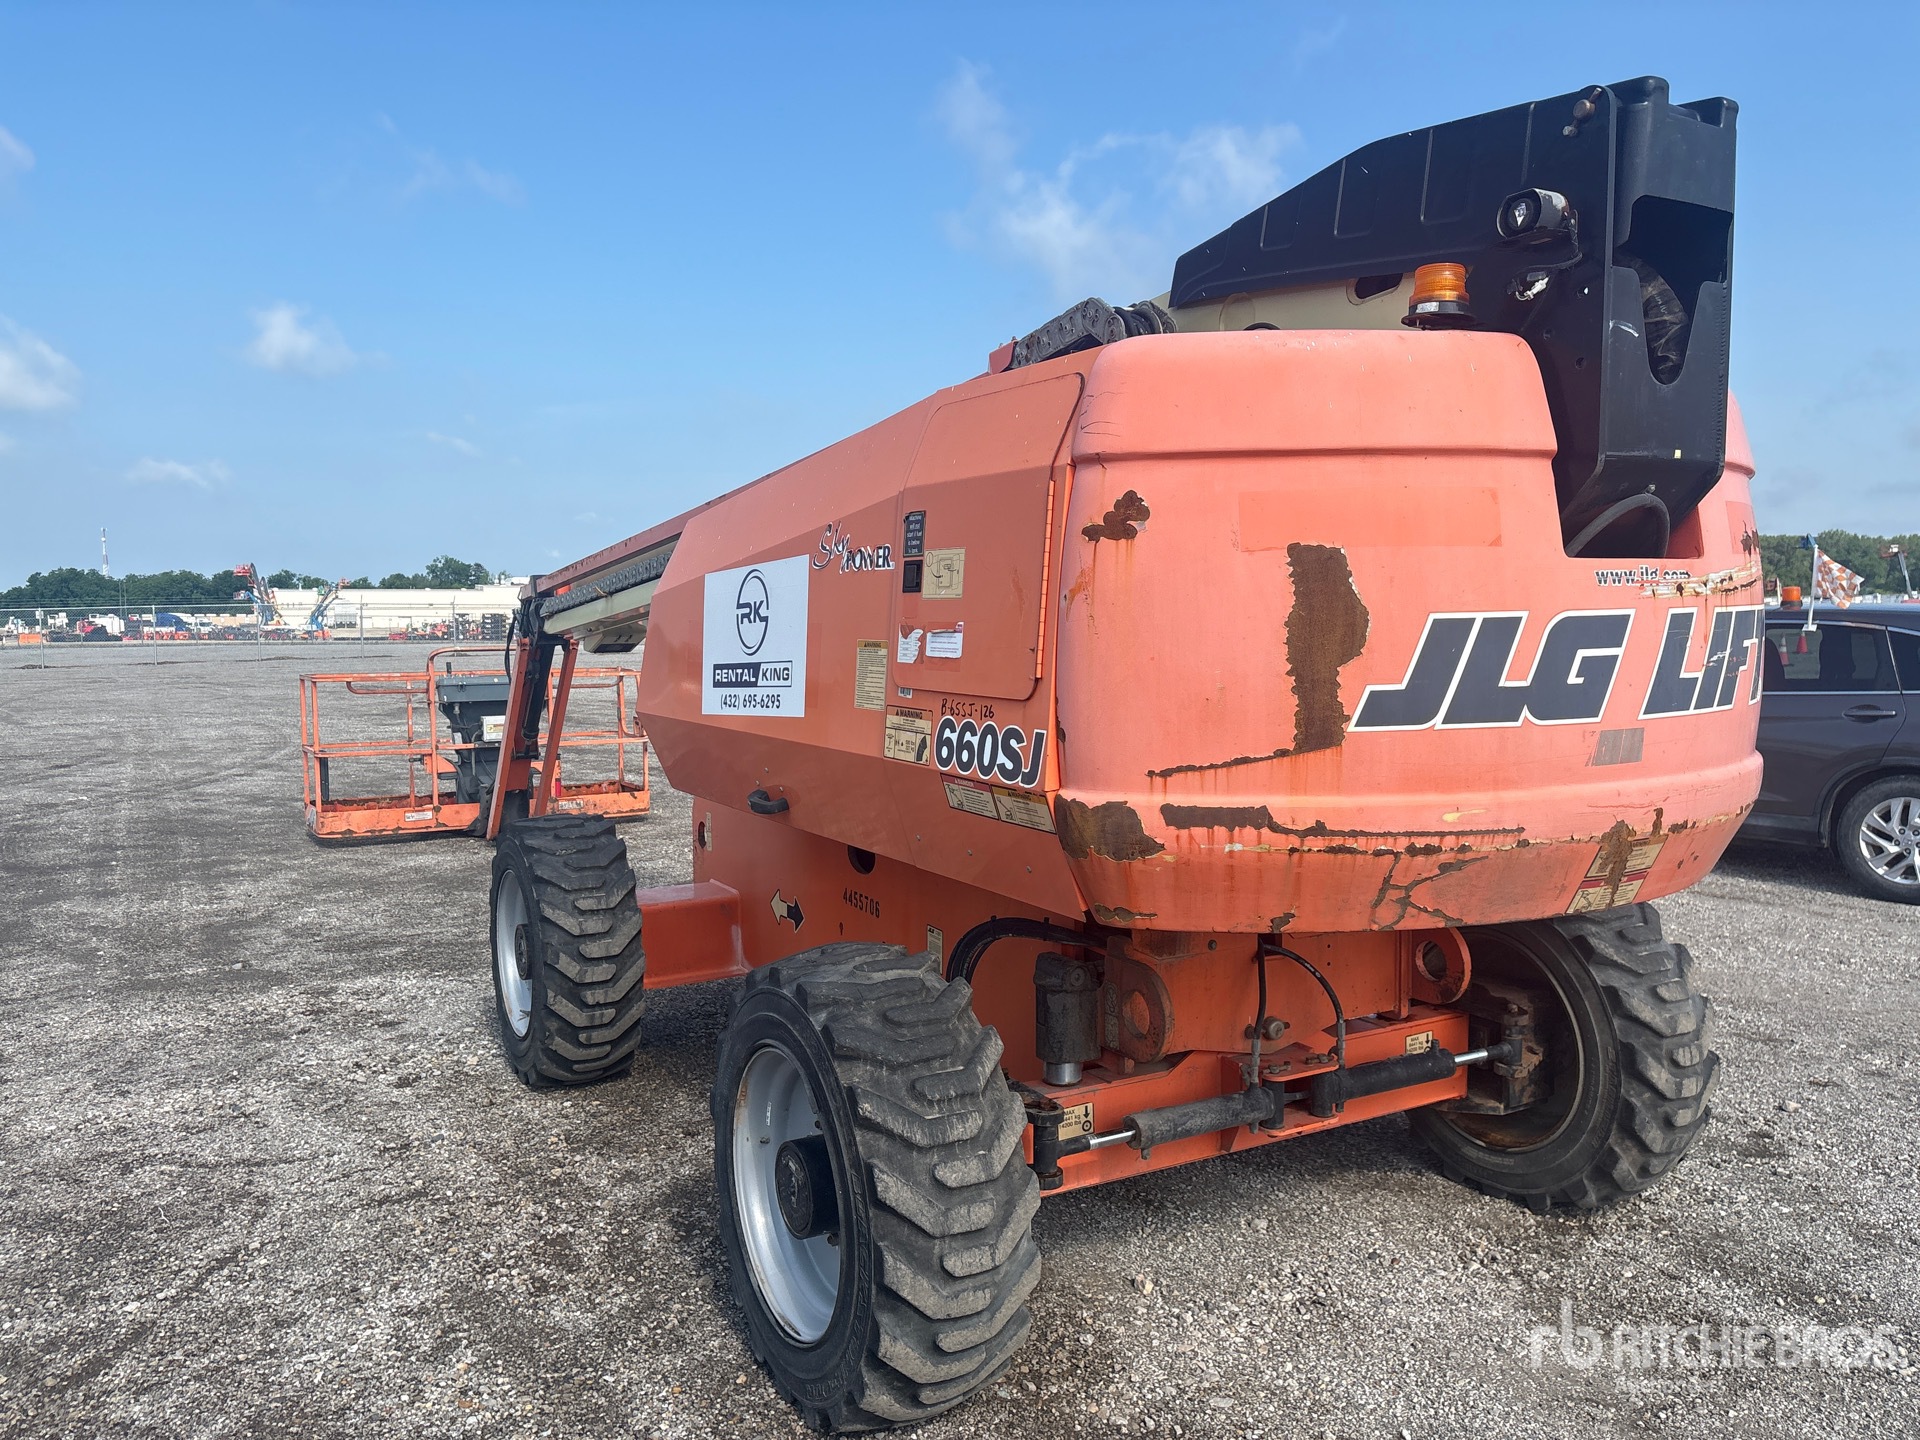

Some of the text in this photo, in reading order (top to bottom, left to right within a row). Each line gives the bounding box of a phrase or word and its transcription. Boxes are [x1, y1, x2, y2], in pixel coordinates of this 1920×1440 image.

[715, 667, 790, 682] RENTAL KING
[1347, 610, 1636, 732] JLG
[720, 693, 781, 711] (432) 695-6295
[900, 709, 923, 720] WARNING
[934, 715, 1047, 789] 660SJ
[842, 887, 881, 919] 4455706
